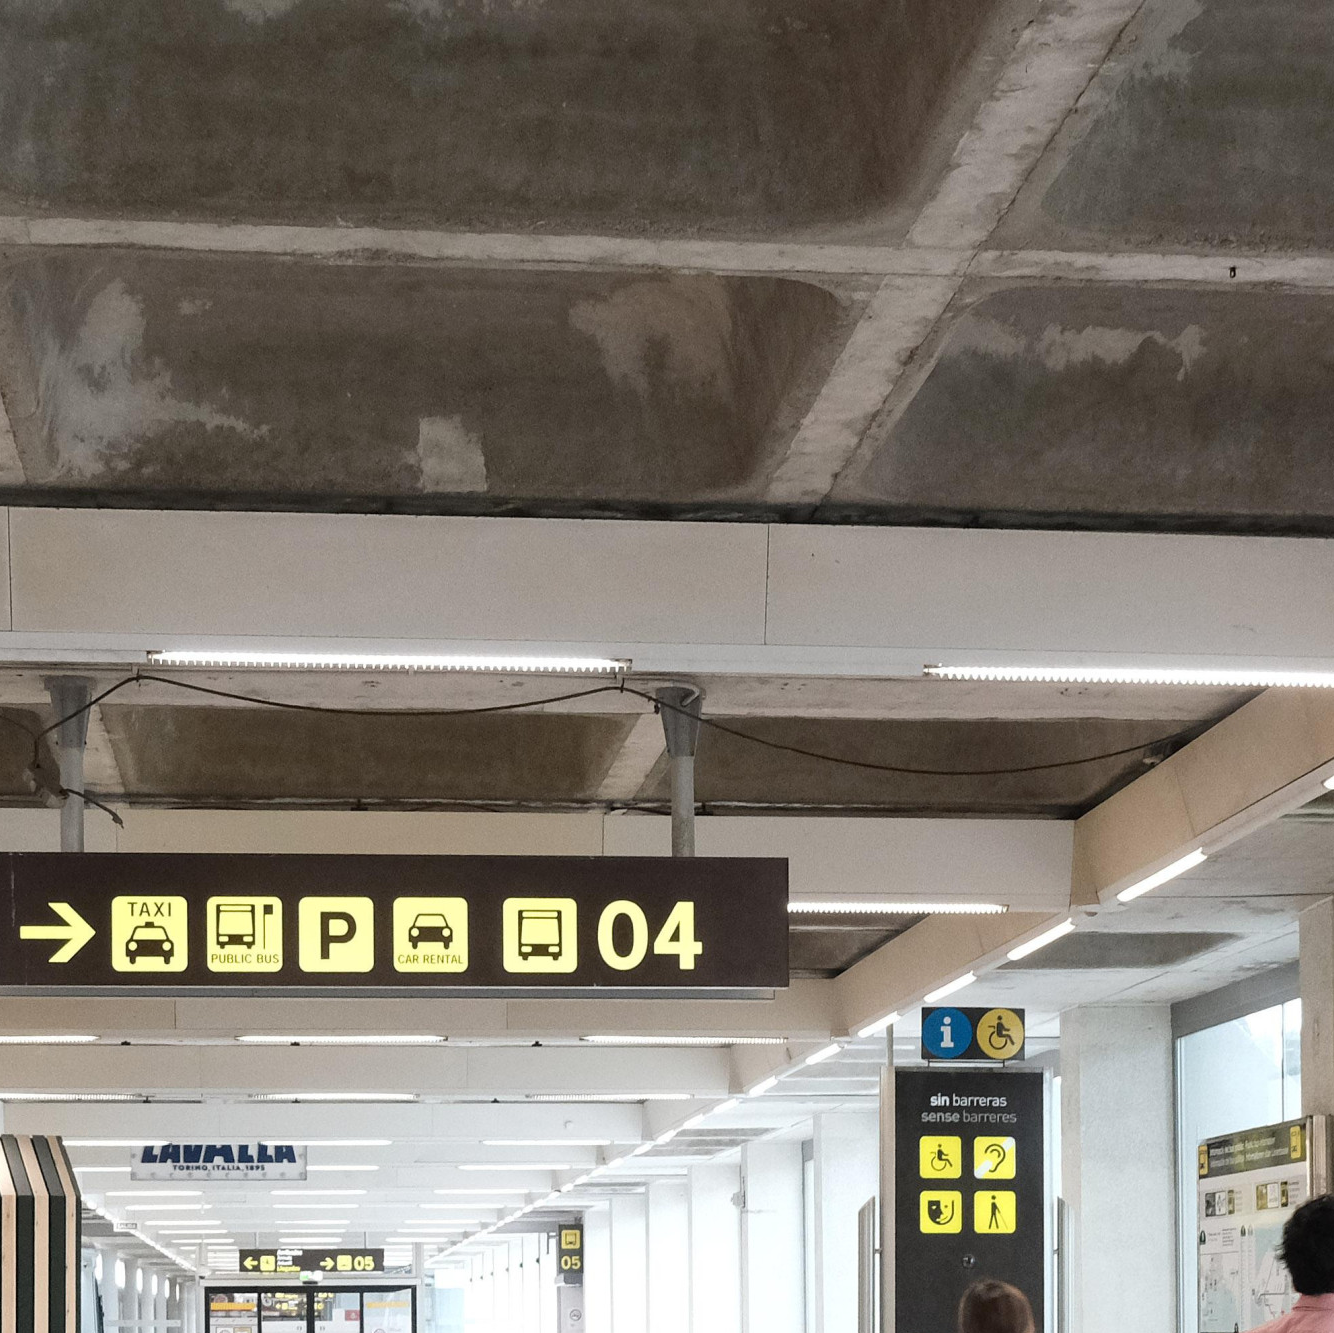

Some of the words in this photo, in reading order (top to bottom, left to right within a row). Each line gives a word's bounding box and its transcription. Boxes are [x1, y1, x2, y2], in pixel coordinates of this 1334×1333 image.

[127, 902, 172, 917] TAXI
[320, 911, 357, 960] P
[597, 899, 703, 971] 04
[211, 954, 252, 964] PUBLIC
[256, 954, 279, 964] BUS
[397, 954, 419, 965] CAR
[423, 954, 464, 965] RENTAL
[930, 1093, 949, 1107] sin
[952, 1093, 1008, 1107] barreras
[921, 1111, 960, 1123] sense
[962, 1109, 1017, 1123] barreres
[354, 1255, 375, 1270] 05
[561, 1255, 581, 1269] 05
